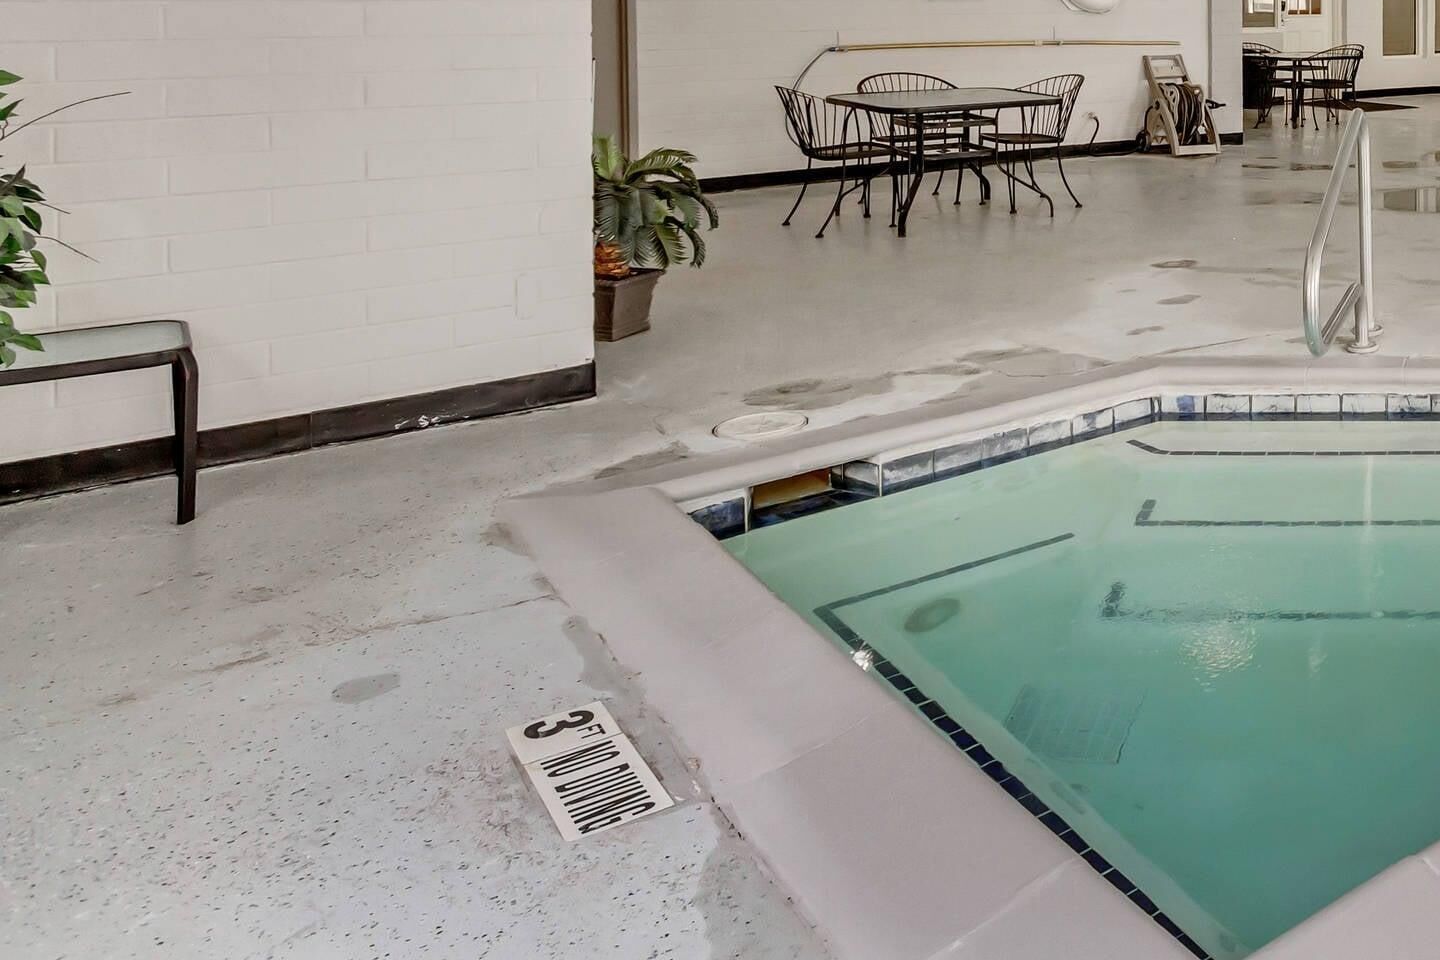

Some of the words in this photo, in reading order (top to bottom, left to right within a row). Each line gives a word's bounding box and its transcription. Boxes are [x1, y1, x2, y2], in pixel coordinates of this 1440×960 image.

[523, 710, 594, 739] 3
[577, 723, 606, 739] FT
[540, 740, 621, 778] NO
[554, 763, 656, 834] DIVING
